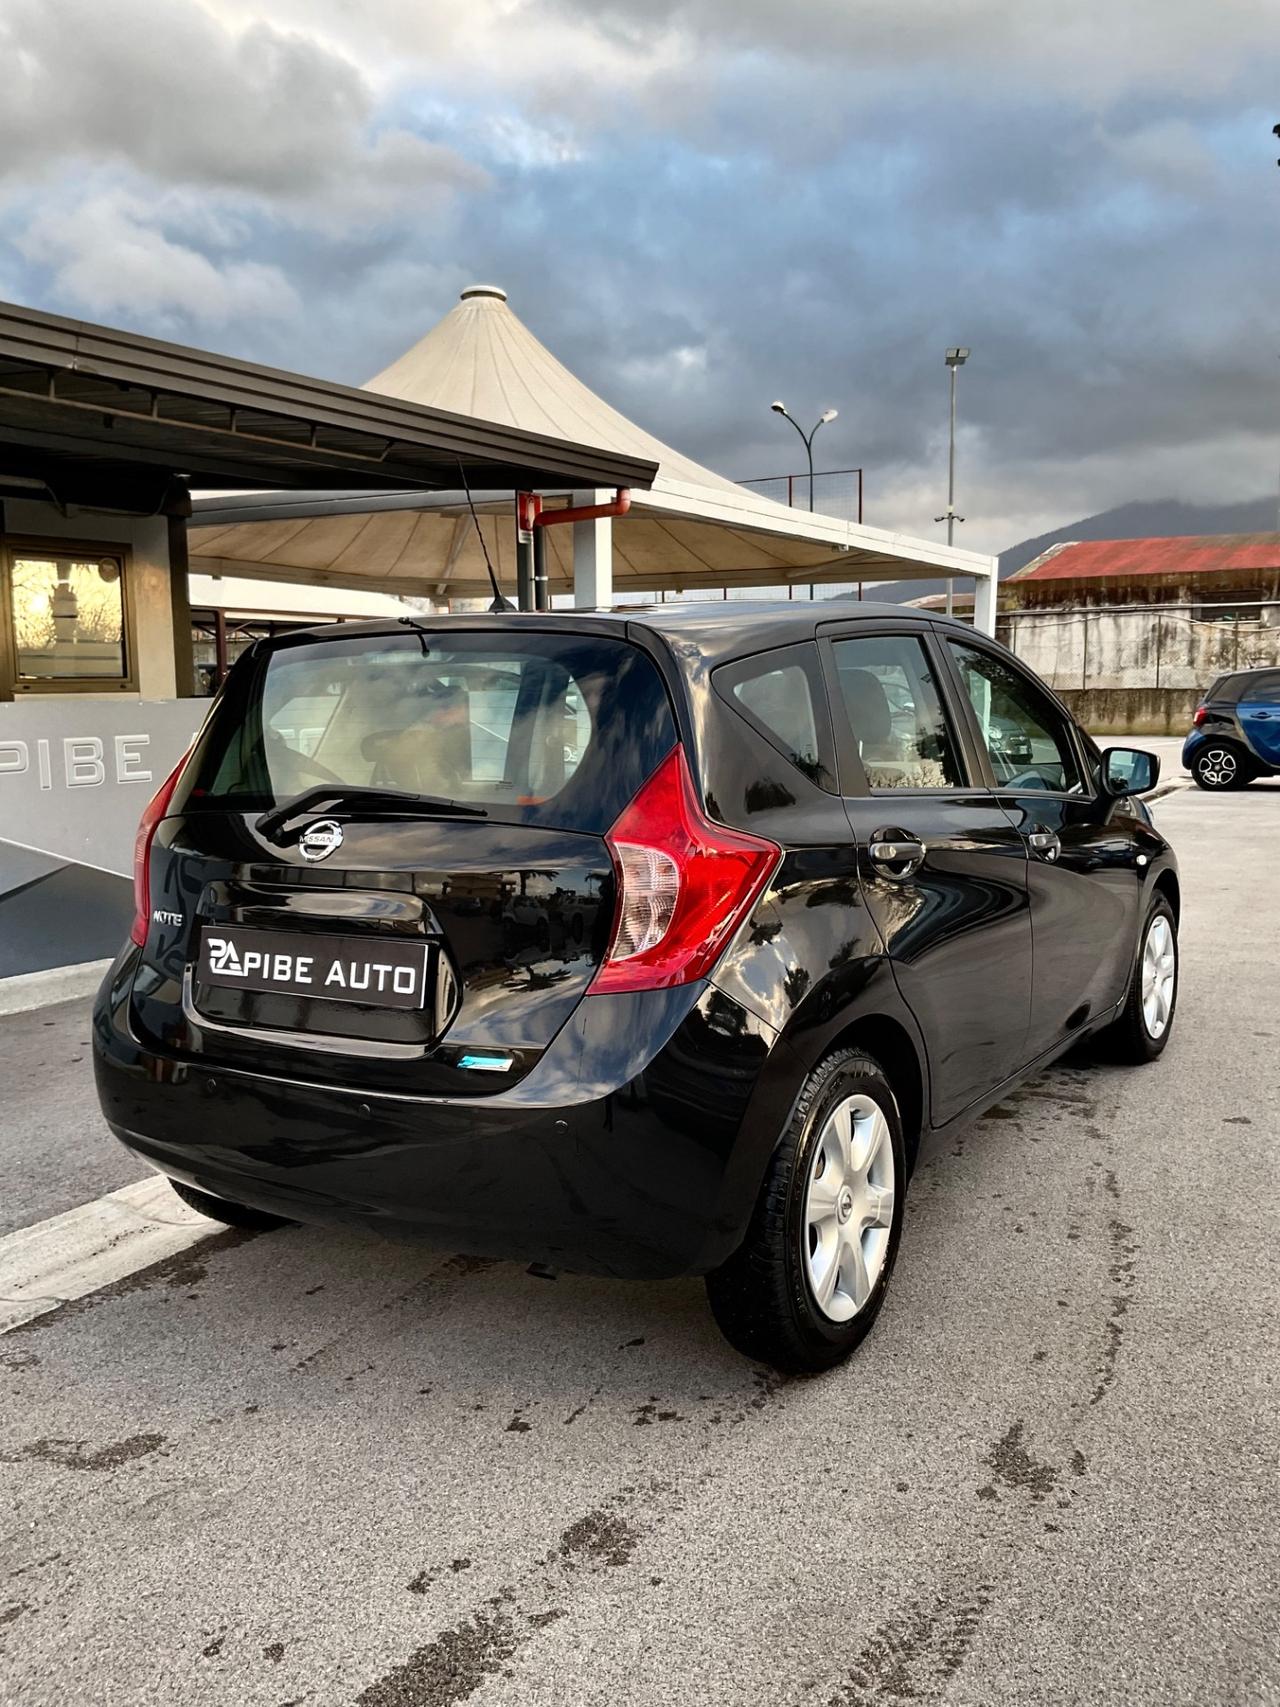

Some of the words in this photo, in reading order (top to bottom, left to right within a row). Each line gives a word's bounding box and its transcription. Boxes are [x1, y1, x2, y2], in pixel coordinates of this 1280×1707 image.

[0, 734, 152, 790] PIBE
[153, 910, 182, 926] NOTE
[243, 951, 313, 984] PIBE
[324, 960, 416, 994] AUTO
